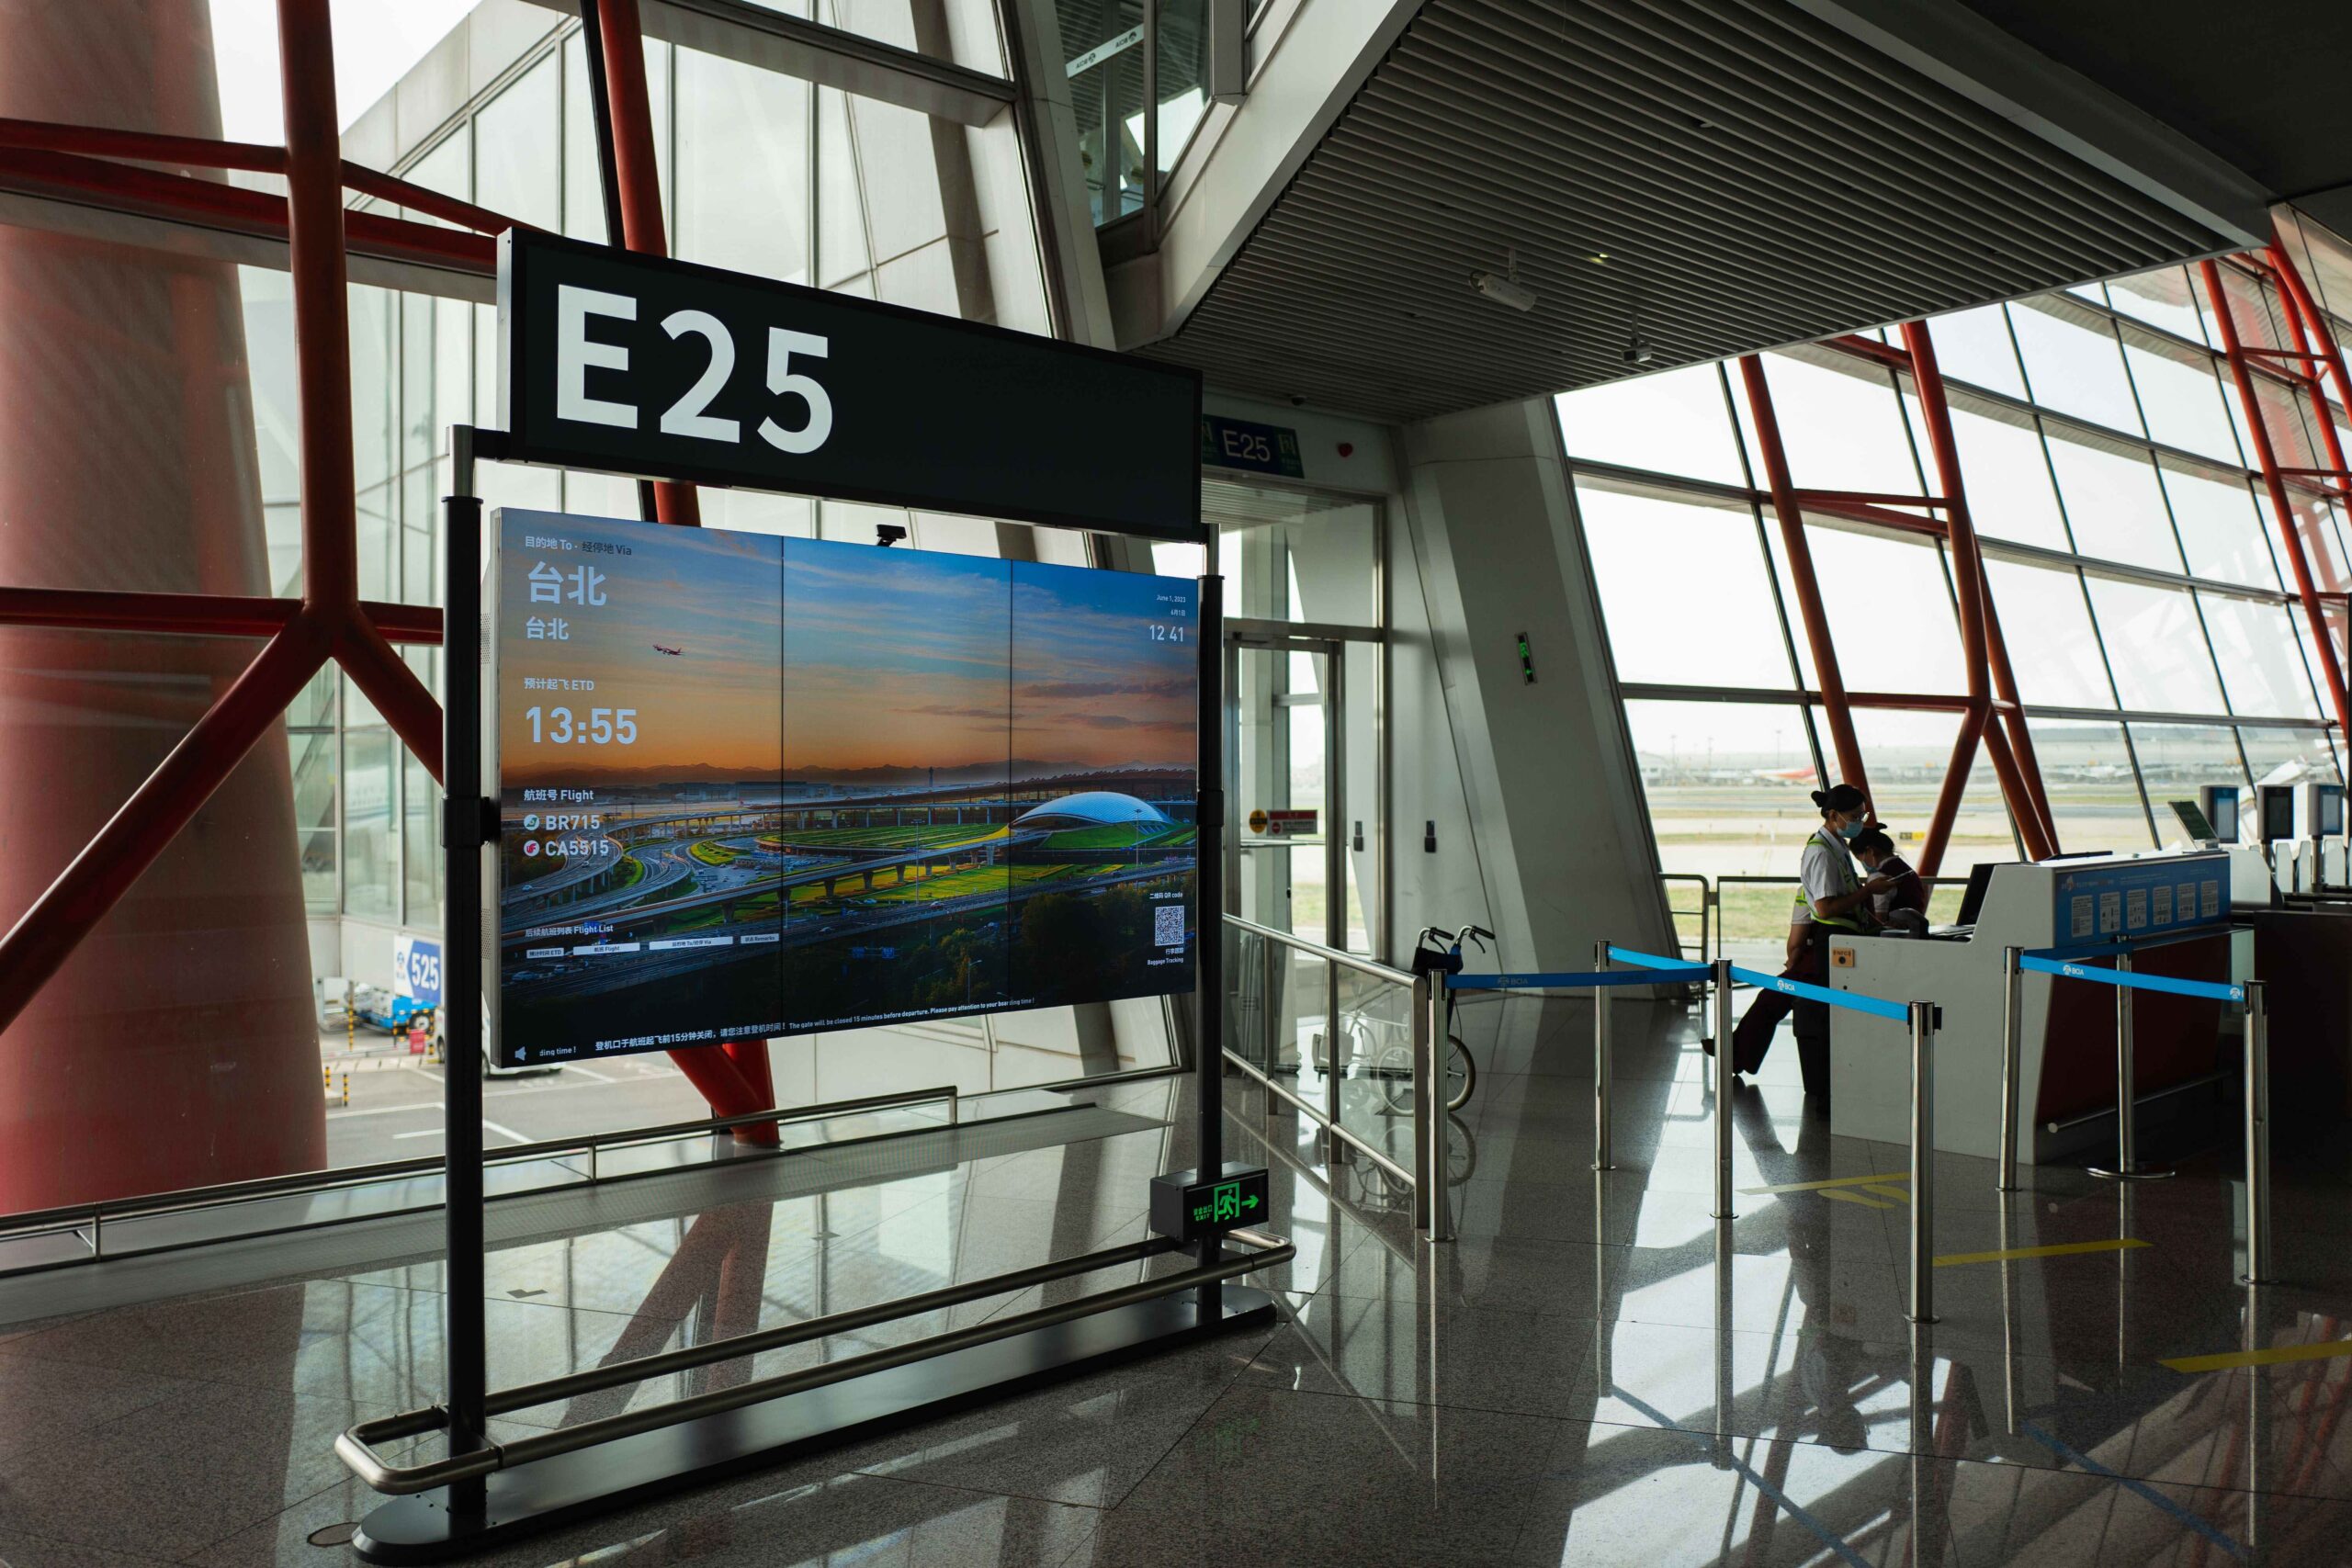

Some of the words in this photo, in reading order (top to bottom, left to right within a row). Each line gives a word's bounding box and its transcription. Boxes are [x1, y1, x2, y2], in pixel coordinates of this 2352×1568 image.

[557, 284, 832, 454] E25
[1222, 429, 1271, 462] E25
[525, 536, 558, 549] 目的地
[560, 539, 572, 550] To
[582, 541, 615, 555] 经停地
[616, 544, 632, 556] Via
[527, 560, 607, 606] 台北
[526, 615, 570, 640] 台北
[524, 677, 570, 691] 预计起飞
[571, 680, 594, 691] ETD
[526, 705, 638, 745] 13:55
[524, 789, 558, 801] 航班号
[560, 789, 594, 803] Flight
[545, 815, 600, 830] BR715
[545, 840, 609, 856] CA5515
[526, 926, 572, 937] 后续航班列表
[573, 926, 597, 935] Flight
[412, 952, 439, 991] 525
[861, 1013, 883, 1021] minutes
